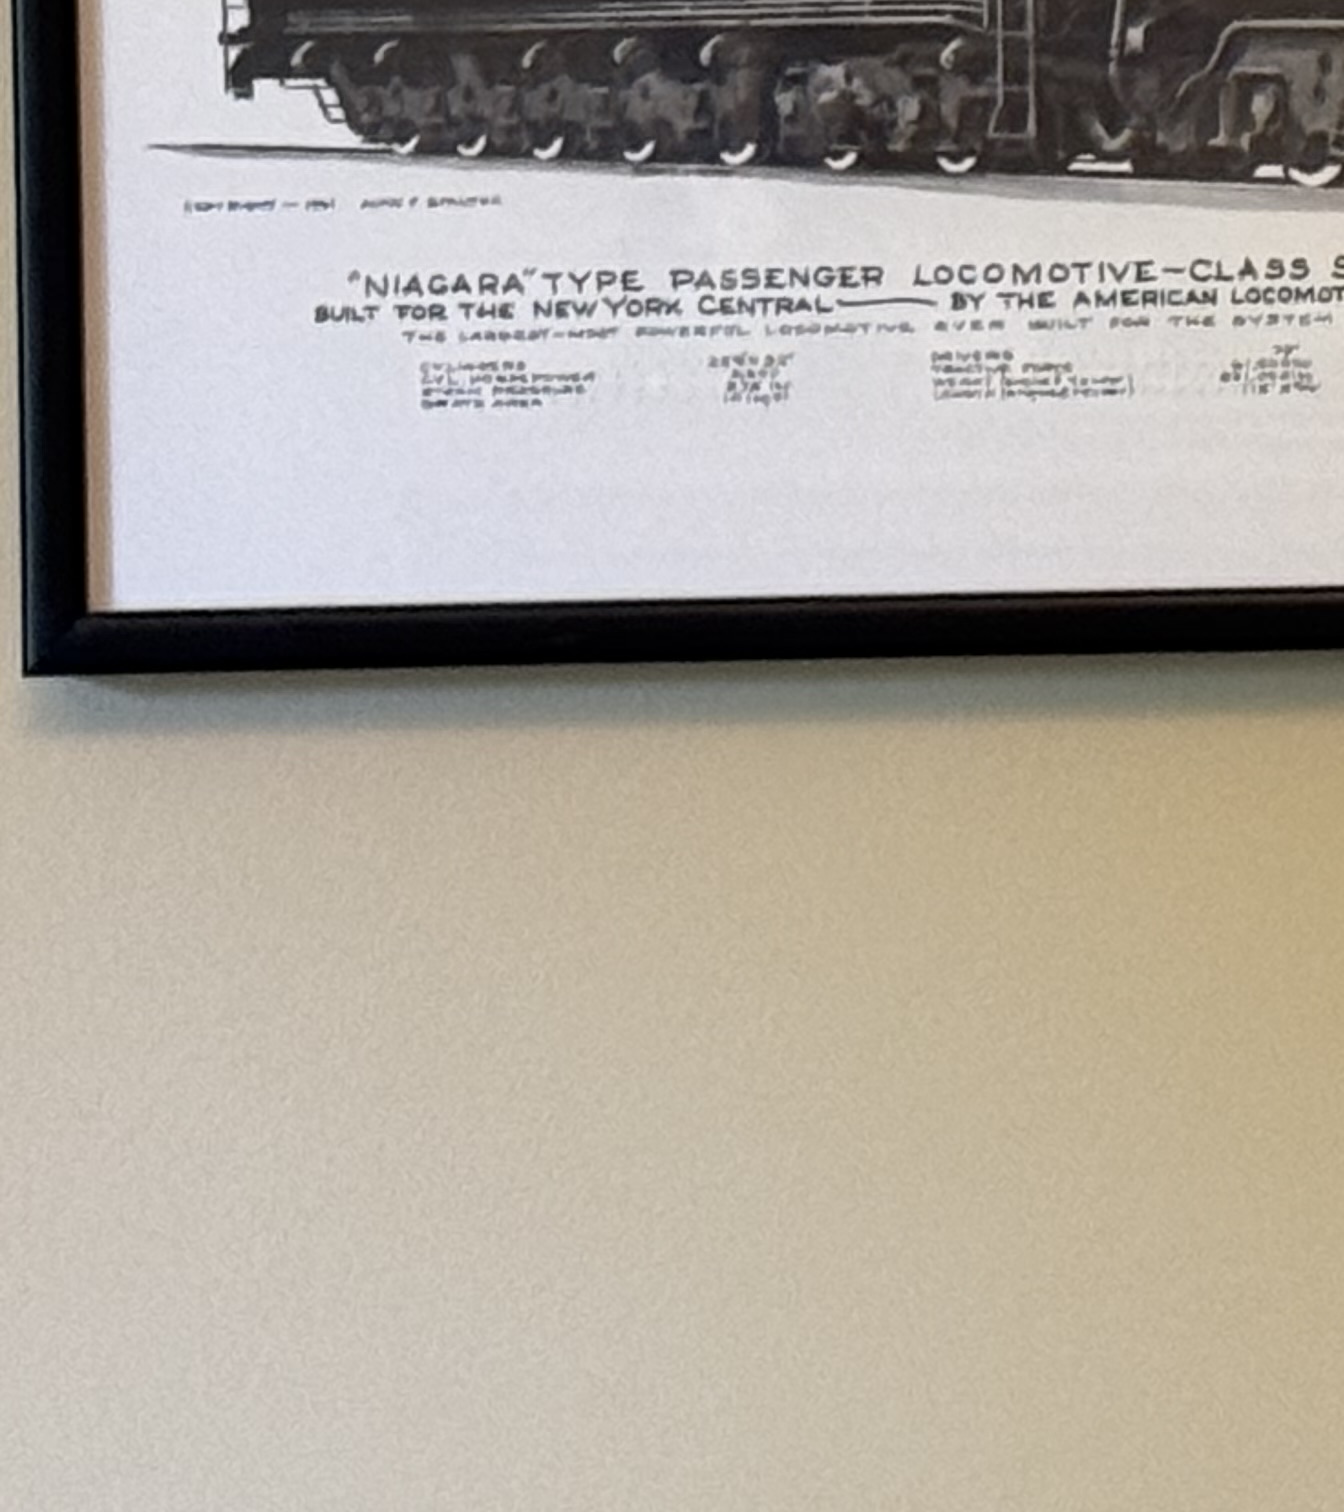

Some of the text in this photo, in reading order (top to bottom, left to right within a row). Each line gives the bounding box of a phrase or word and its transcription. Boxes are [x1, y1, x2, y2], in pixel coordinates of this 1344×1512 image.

[541, 268, 645, 294] TYPE
[668, 264, 886, 292] PASSENGER
[314, 303, 381, 325] BUILT
[392, 301, 449, 323] FOR
[457, 300, 516, 321] THE
[531, 298, 599, 321] NEW
[600, 295, 684, 319] YORK
[949, 290, 987, 313] BY
[994, 289, 1058, 311] THE
[1071, 287, 1219, 309] AMERICAN
